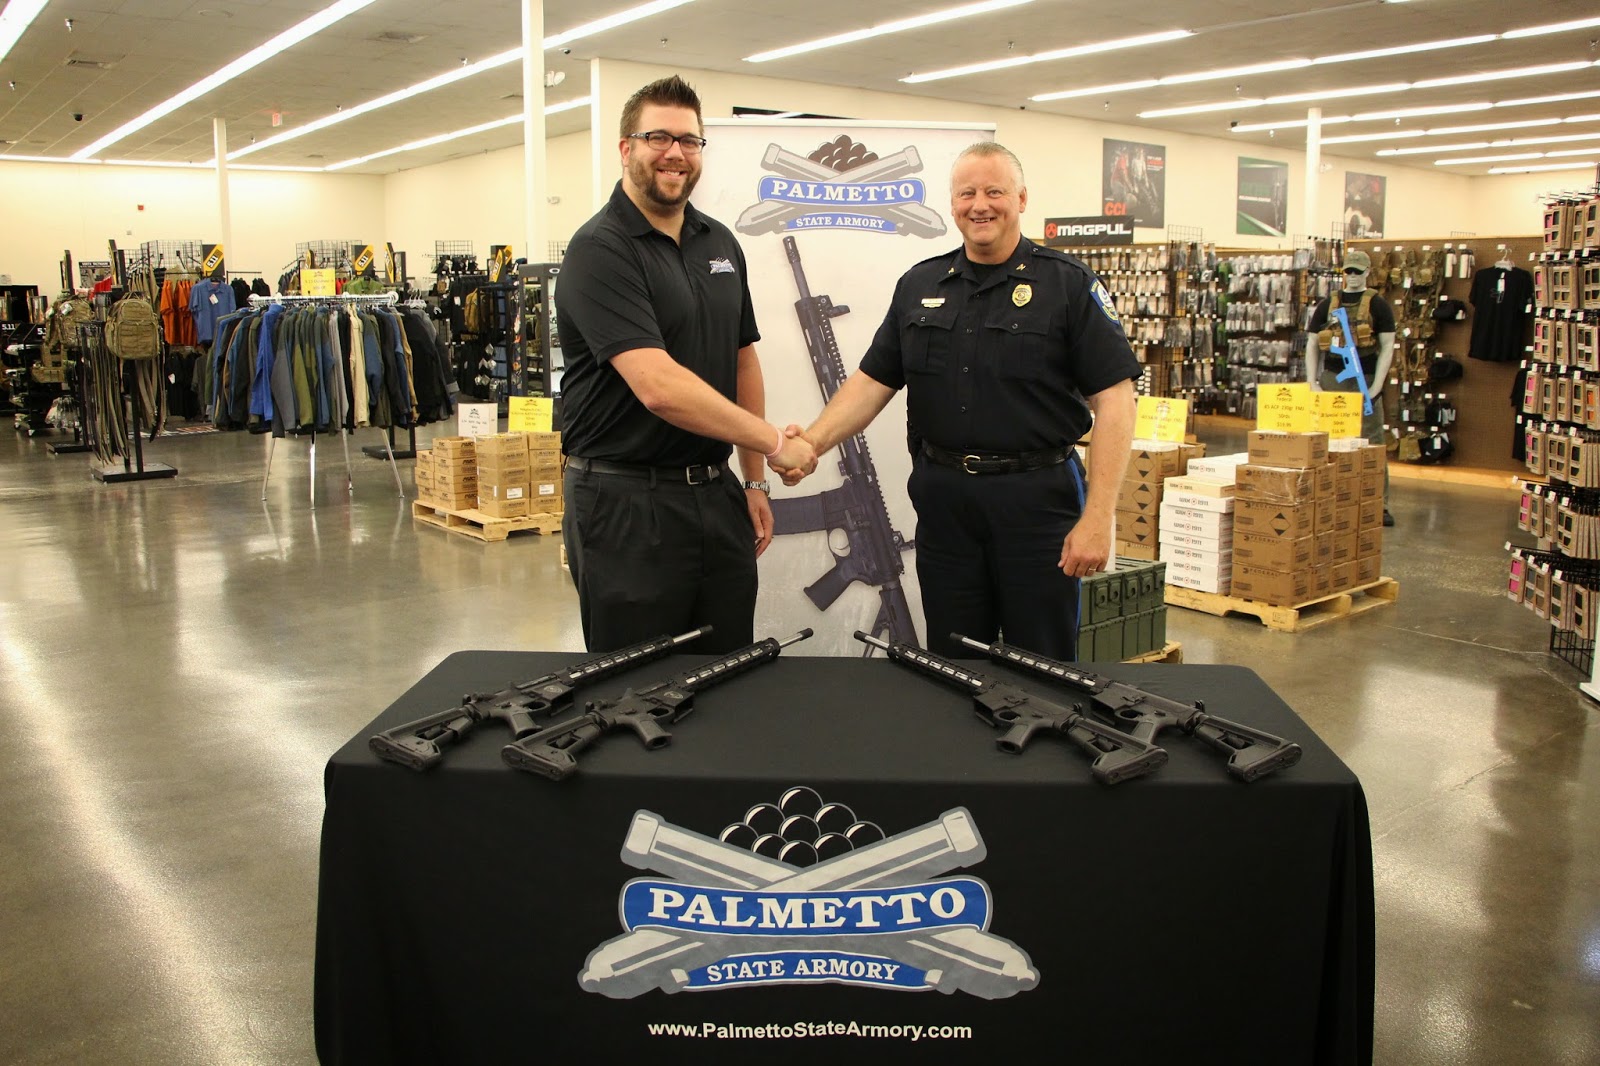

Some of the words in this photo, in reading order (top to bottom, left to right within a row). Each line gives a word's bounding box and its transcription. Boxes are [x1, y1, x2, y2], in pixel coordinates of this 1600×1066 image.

[770, 180, 915, 202] PALMETTO
[1104, 201, 1127, 216] CCI
[796, 216, 832, 228] STATE
[835, 216, 885, 229] ARMORY
[1057, 223, 1132, 236] MAGPUL
[647, 887, 966, 929] PALMETTO
[706, 959, 786, 982] STATE
[793, 958, 900, 981] ARMORY
[647, 1020, 972, 1041] www.PalmettoStateArmory.com
